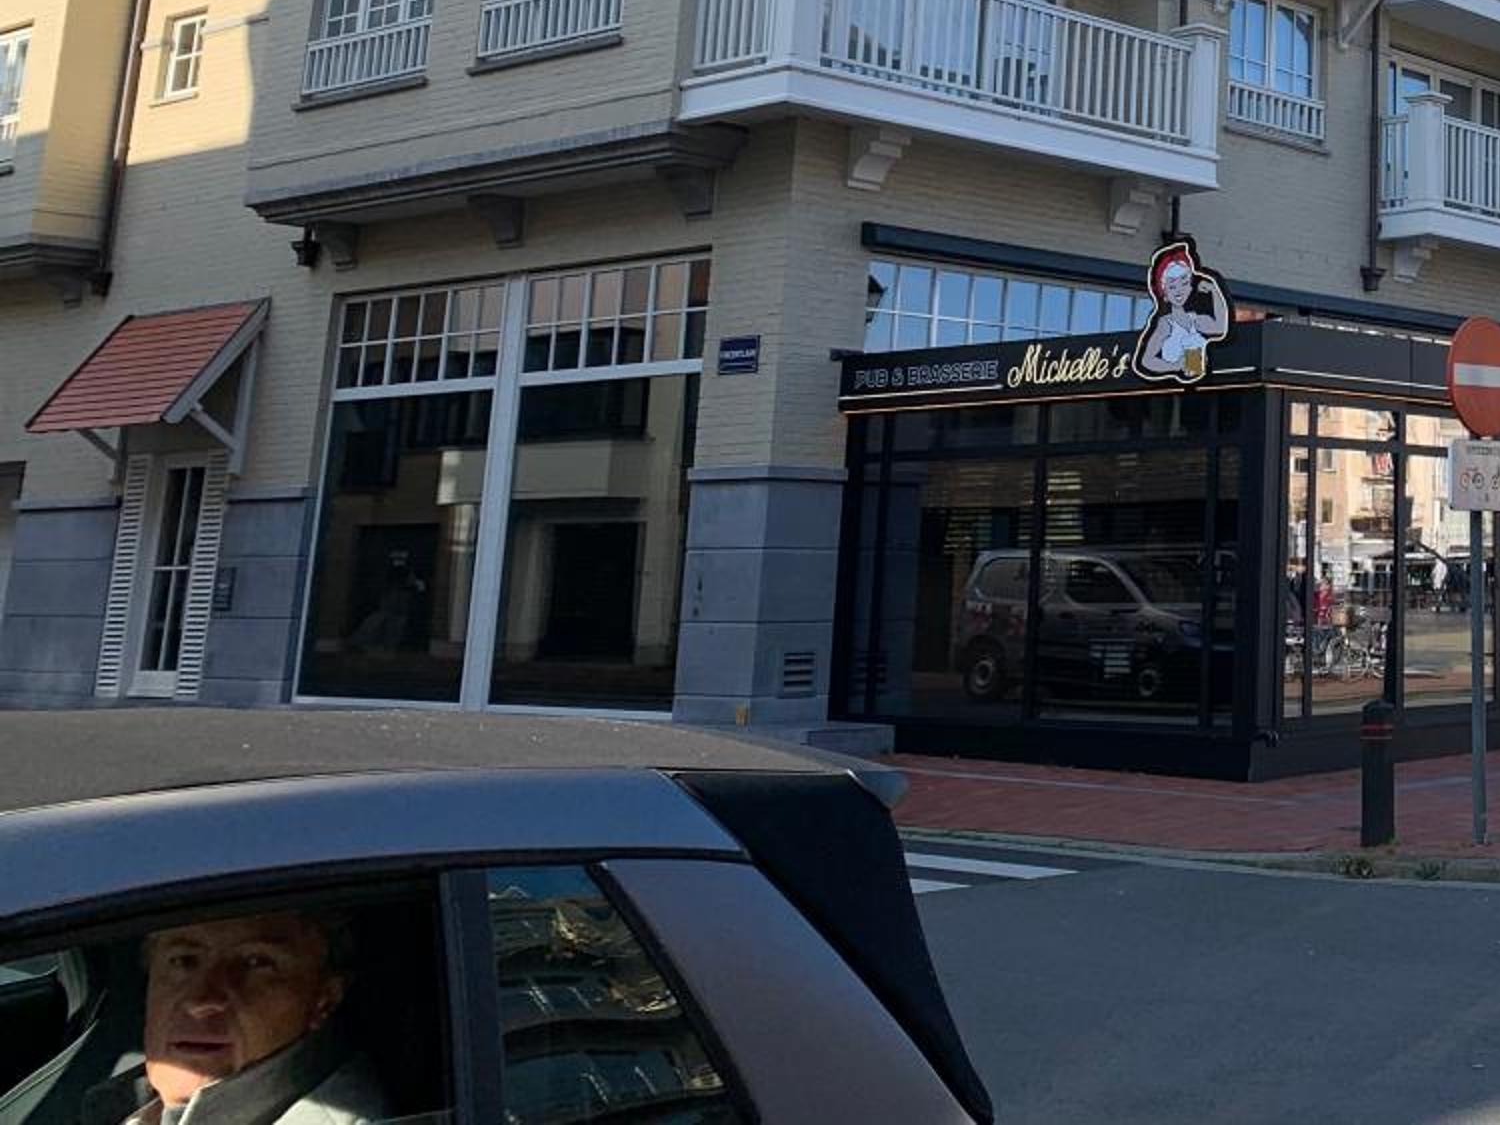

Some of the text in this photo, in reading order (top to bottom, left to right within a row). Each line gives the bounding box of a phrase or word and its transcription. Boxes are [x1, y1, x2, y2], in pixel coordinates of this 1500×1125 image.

[854, 359, 999, 389] PUB & BRASSERIE
[1007, 344, 1130, 388] Michelle's
